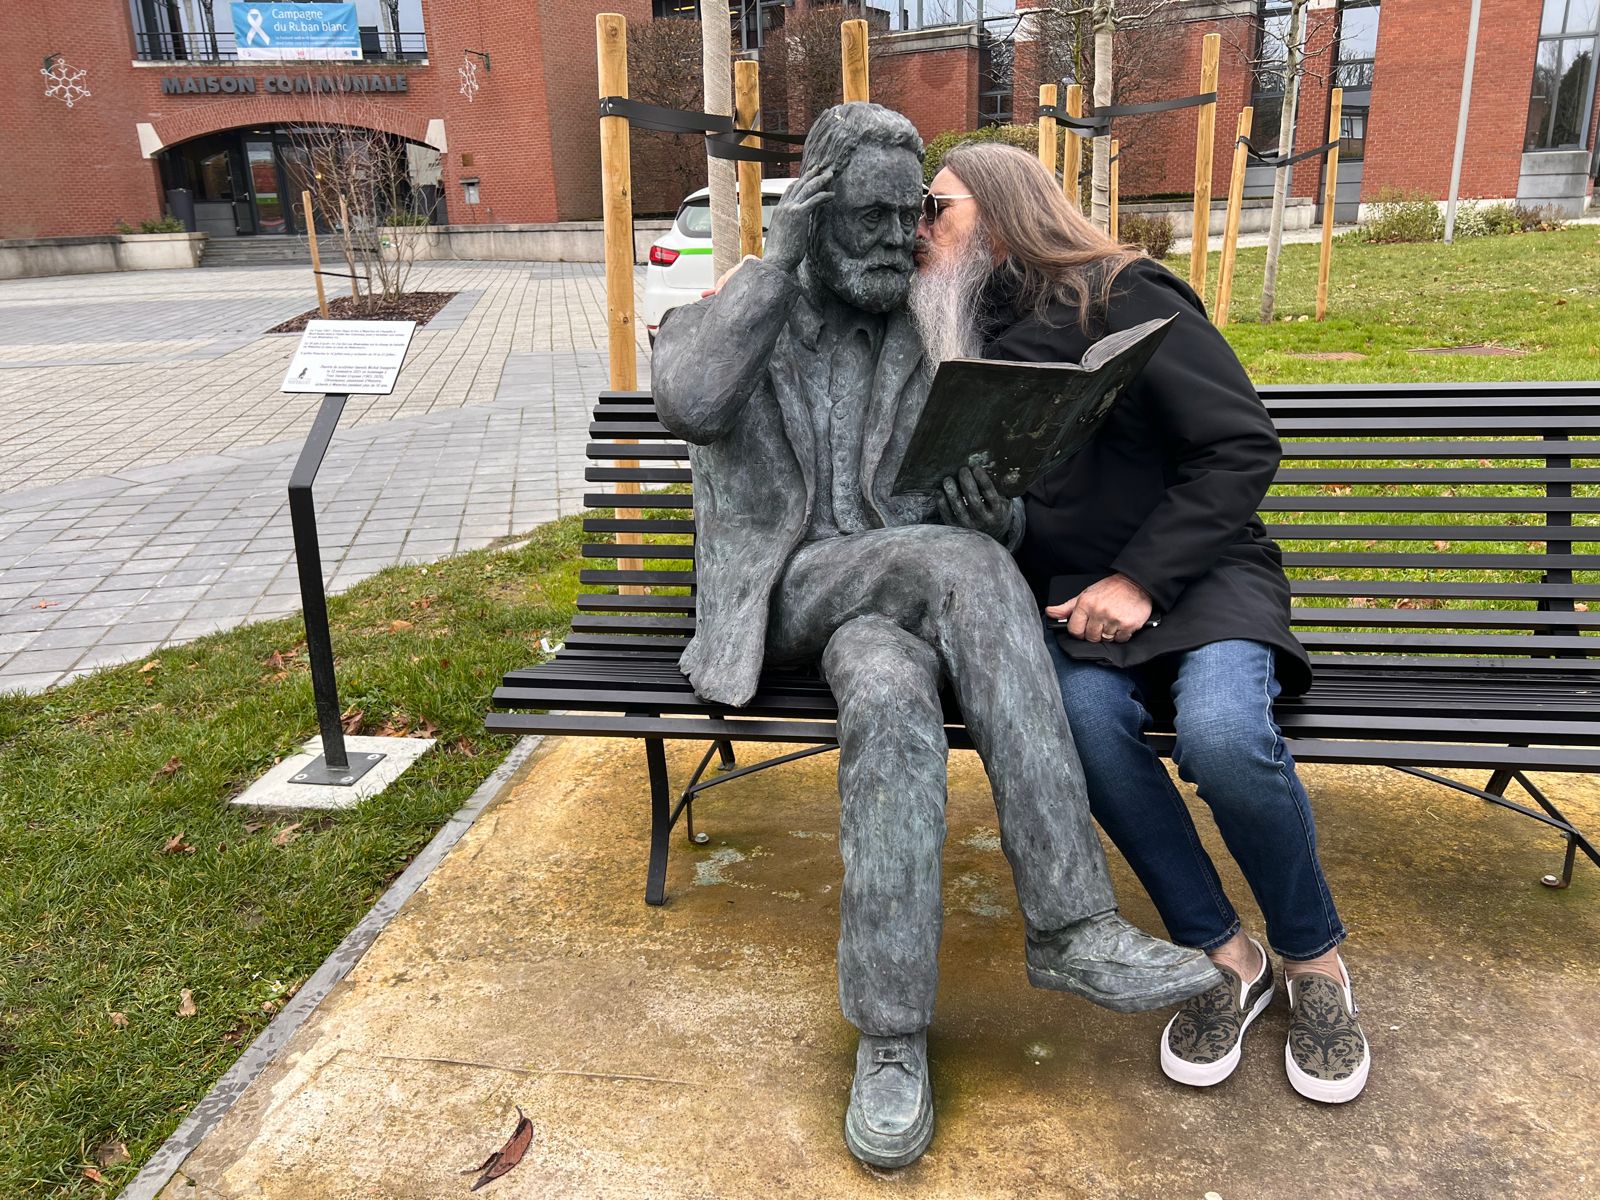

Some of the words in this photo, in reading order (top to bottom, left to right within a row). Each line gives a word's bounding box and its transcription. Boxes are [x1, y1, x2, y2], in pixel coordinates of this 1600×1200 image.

[271, 9, 323, 20] Campagne
[274, 22, 287, 32] du
[289, 22, 320, 32] Ruban
[321, 22, 348, 32] blanc
[161, 75, 256, 95] MAISON
[263, 74, 409, 95] COMMUNALE
